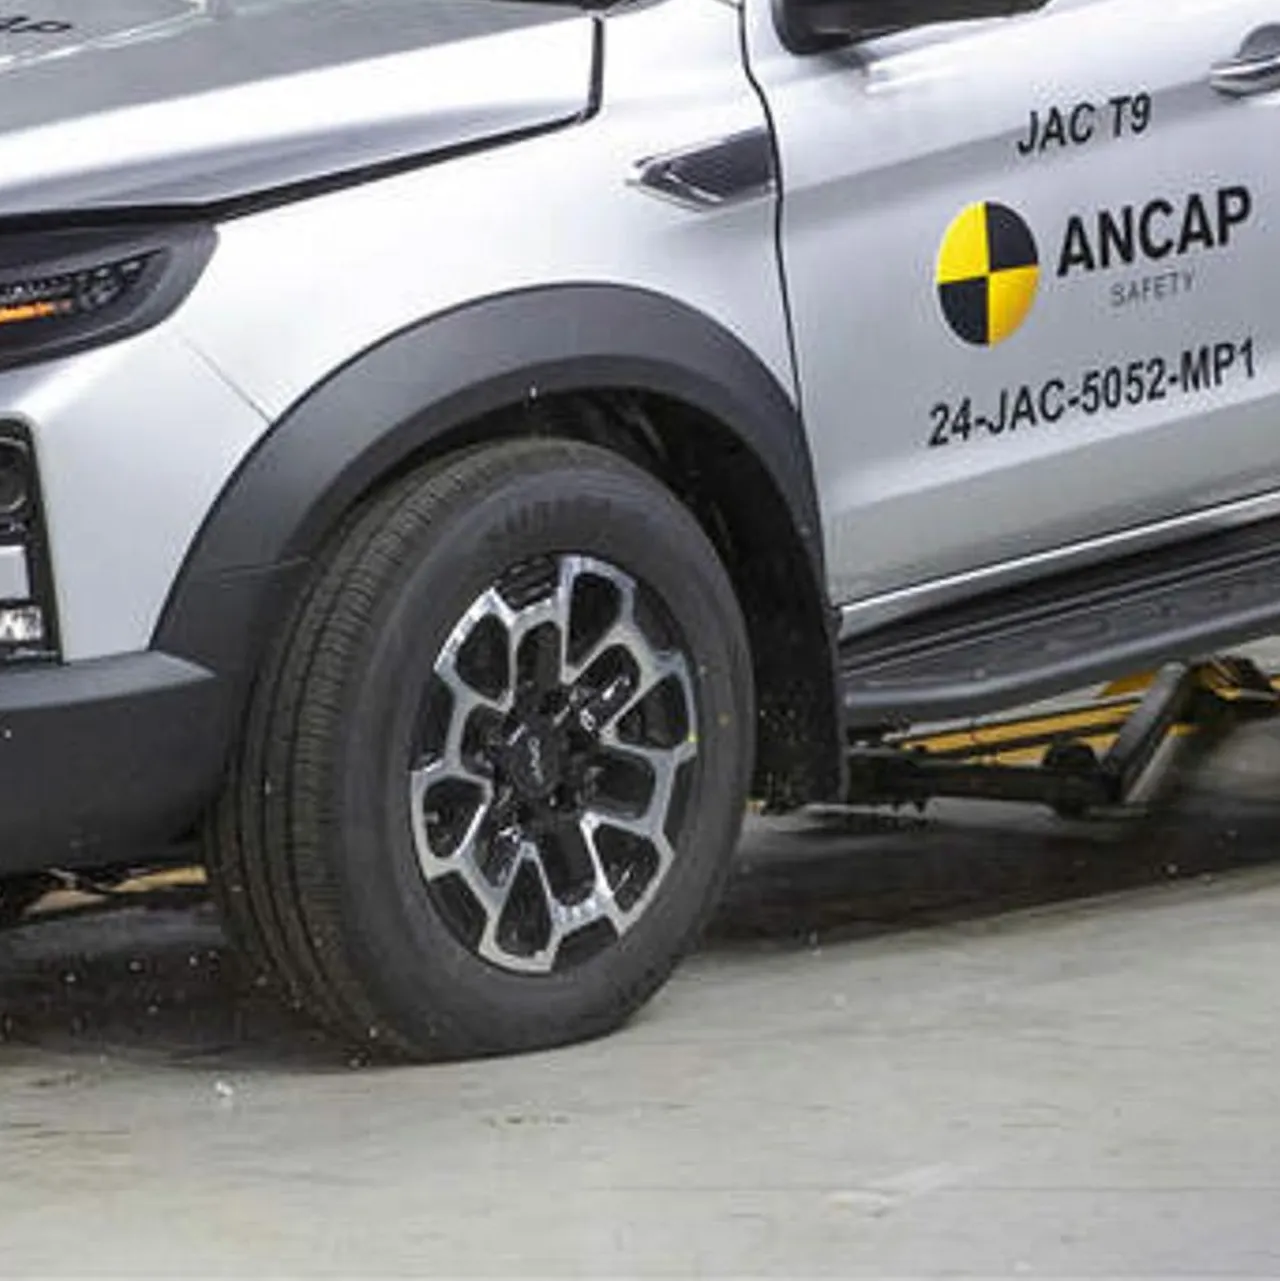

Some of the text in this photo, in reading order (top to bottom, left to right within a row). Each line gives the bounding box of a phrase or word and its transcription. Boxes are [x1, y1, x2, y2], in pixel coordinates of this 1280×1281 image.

[1017, 92, 1153, 155] JAC T9
[1056, 185, 1253, 277] ANCAP
[1110, 271, 1196, 308] SAFETY
[927, 336, 1257, 447] 24-JAC-5052-MP1
